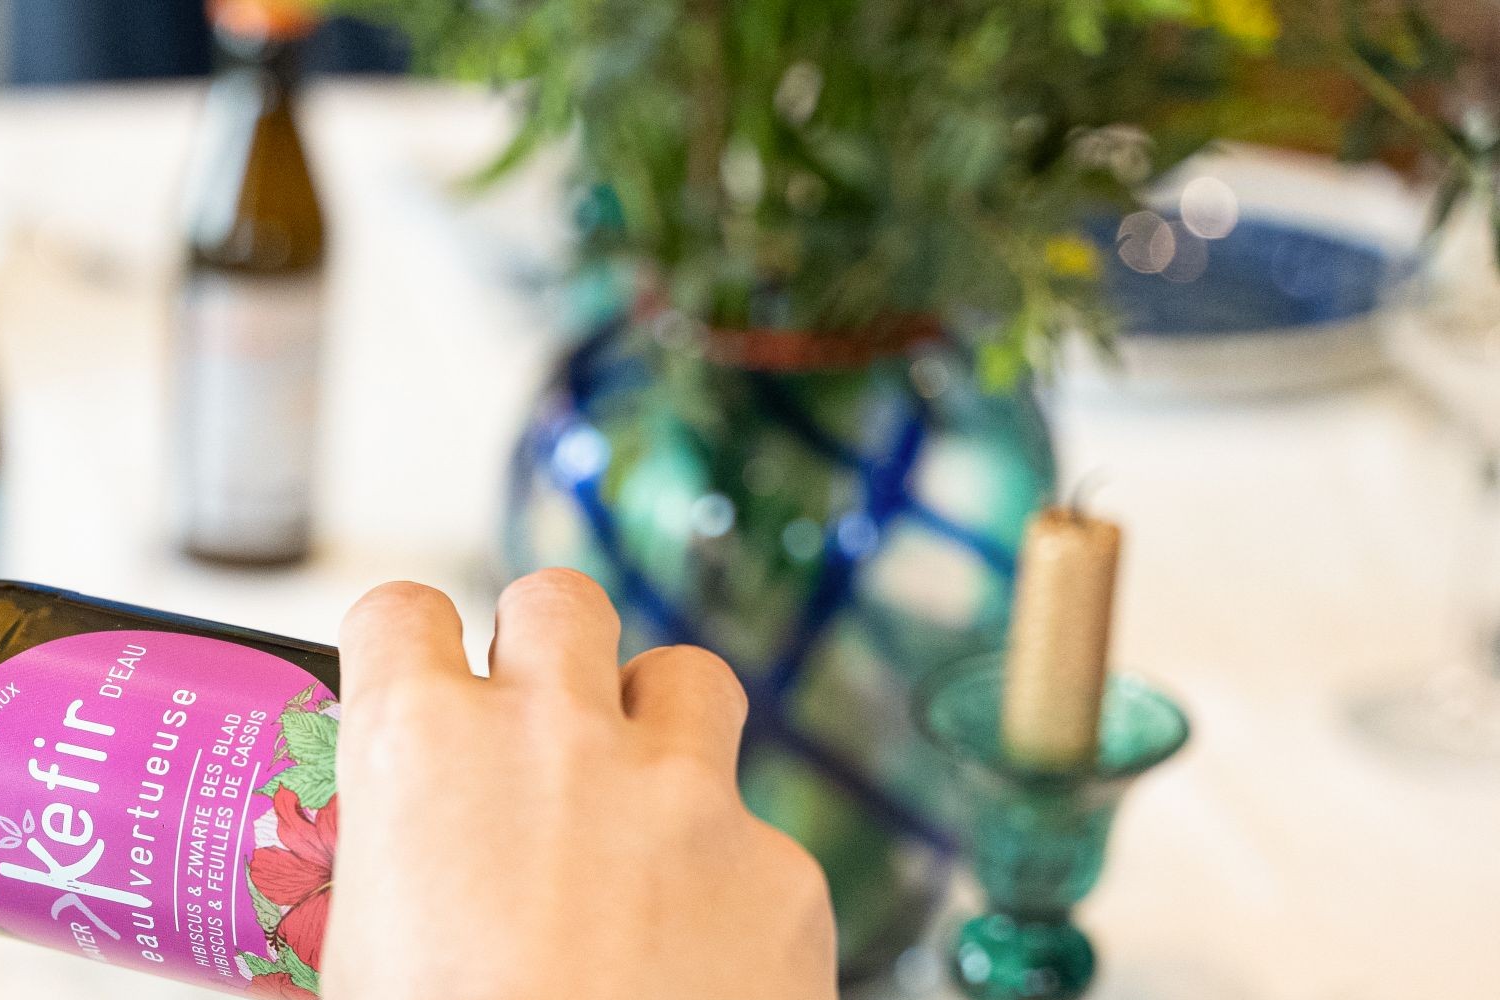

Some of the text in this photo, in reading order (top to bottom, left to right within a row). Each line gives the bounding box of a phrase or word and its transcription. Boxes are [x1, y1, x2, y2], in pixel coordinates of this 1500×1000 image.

[99, 644, 148, 698] D'EAU
[127, 689, 197, 962] eau vertueuse
[186, 713, 242, 967] HIBISCUS & ZWARTE BES BLAD
[208, 710, 267, 976] HIBISCUS & FEUILLES DE CASSIS
